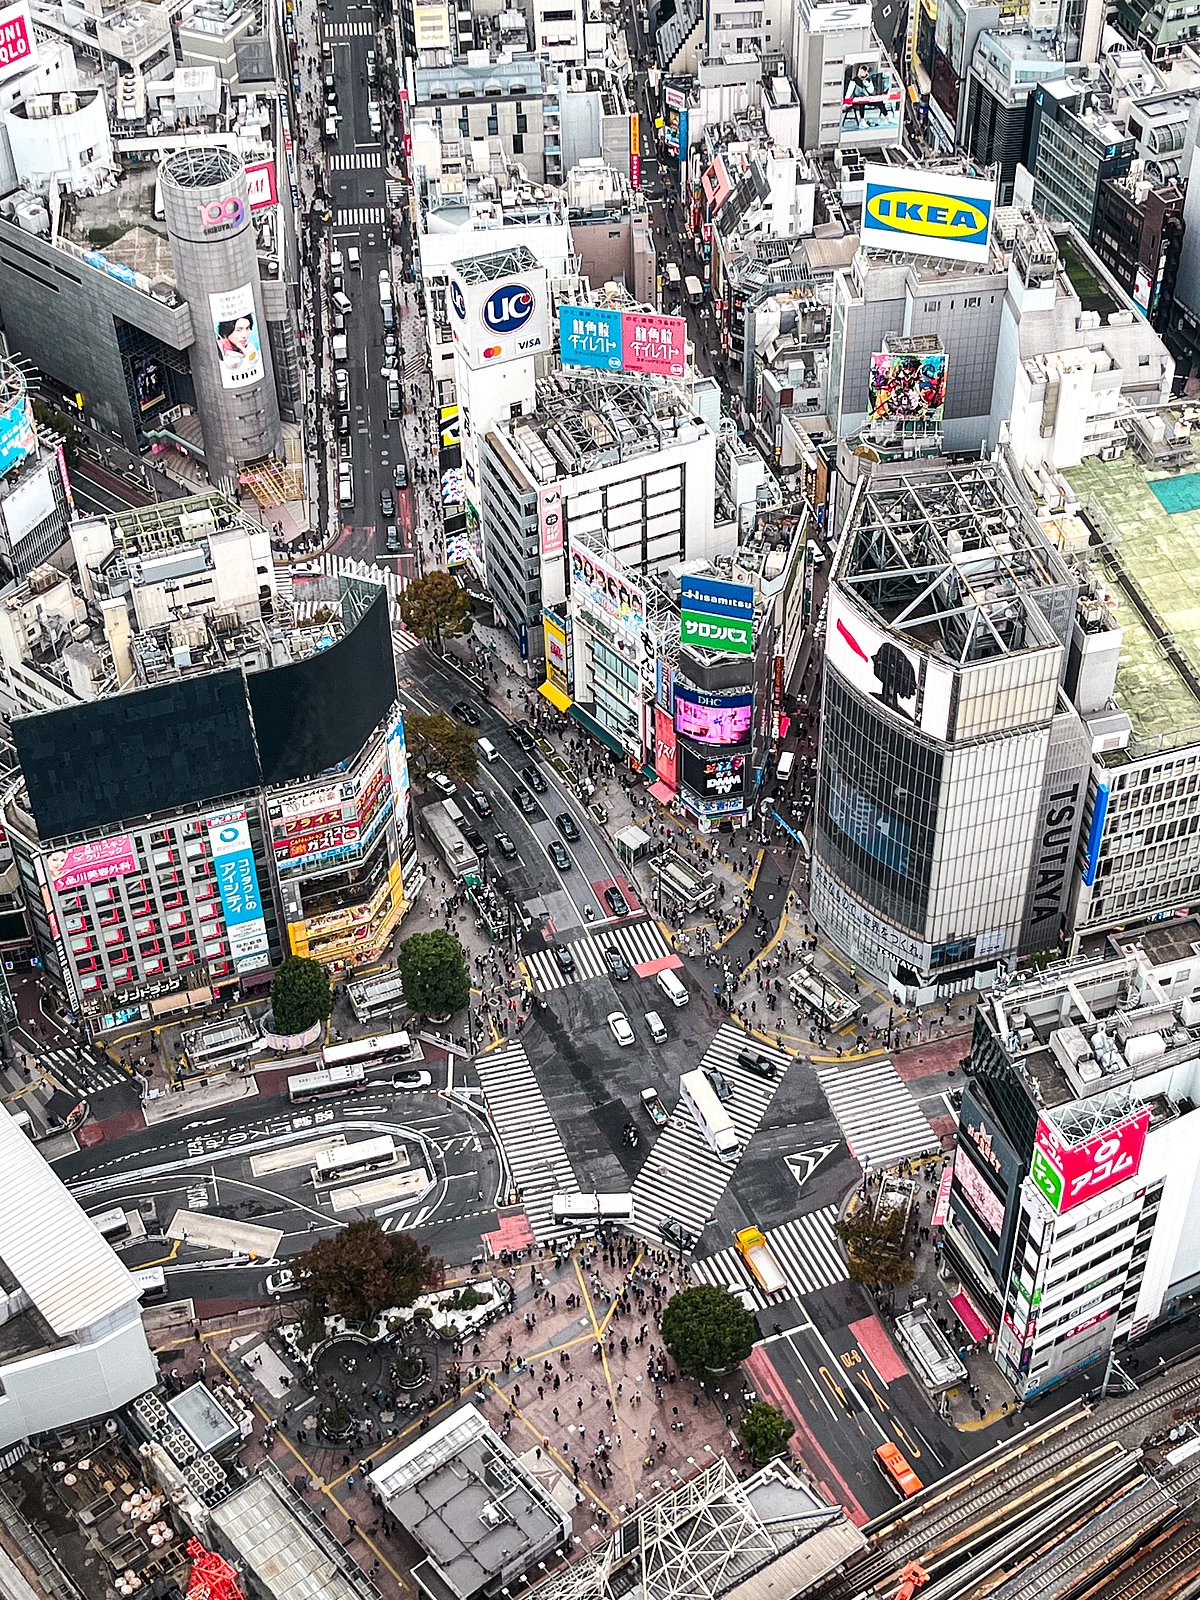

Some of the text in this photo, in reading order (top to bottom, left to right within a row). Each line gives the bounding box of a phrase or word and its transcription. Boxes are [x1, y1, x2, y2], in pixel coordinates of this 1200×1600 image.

[197, 196, 244, 226] 109
[878, 198, 978, 229] IKEA
[518, 337, 541, 349] VISA
[231, 369, 257, 381] uno
[681, 588, 752, 609] Hisamitsu
[684, 620, 748, 645] サロンパス
[697, 695, 722, 707] DHC
[715, 784, 732, 795] TV
[84, 839, 126, 855] 品川スキン
[85, 846, 123, 861] クリニック
[275, 848, 289, 858] 7F
[307, 835, 341, 851] ガスト
[1031, 782, 1079, 926] TSUTAYA
[66, 861, 131, 886] 品川美容外科
[238, 858, 257, 911] コンタクトの
[220, 861, 243, 914] アイシティ
[878, 946, 921, 973] TSUTAYA
[117, 978, 180, 1004] サンドラッグ
[1040, 1132, 1064, 1171] アコム
[1034, 1152, 1056, 1194] レイク
[1070, 1152, 1133, 1196] アコム
